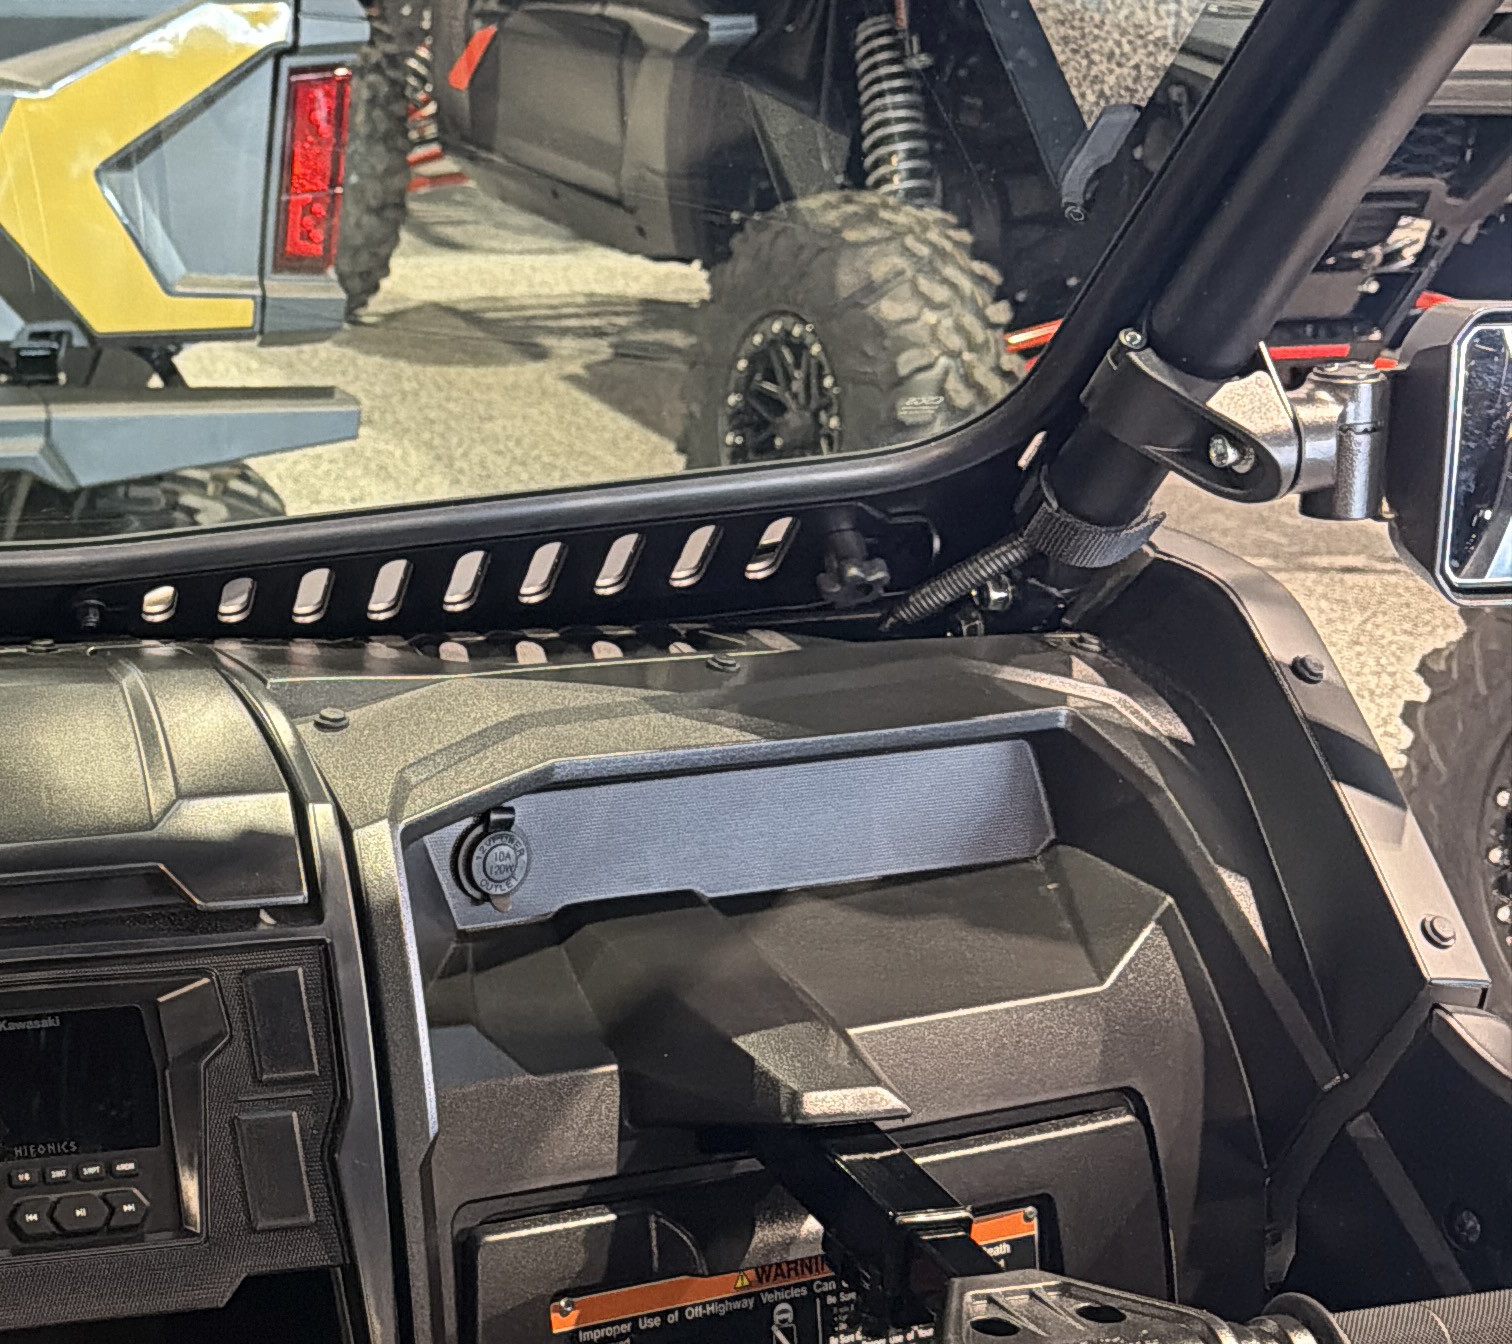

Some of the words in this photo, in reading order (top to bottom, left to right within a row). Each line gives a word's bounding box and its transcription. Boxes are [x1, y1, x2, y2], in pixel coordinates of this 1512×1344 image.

[14, 1140, 78, 1157] HIFONICS
[579, 1321, 632, 1343] Improper
[638, 1315, 661, 1330] Use
[667, 1311, 679, 1324] of
[685, 1296, 755, 1320] Off-Highway
[760, 1286, 808, 1304] Vehicles
[813, 1279, 837, 1294] Can
